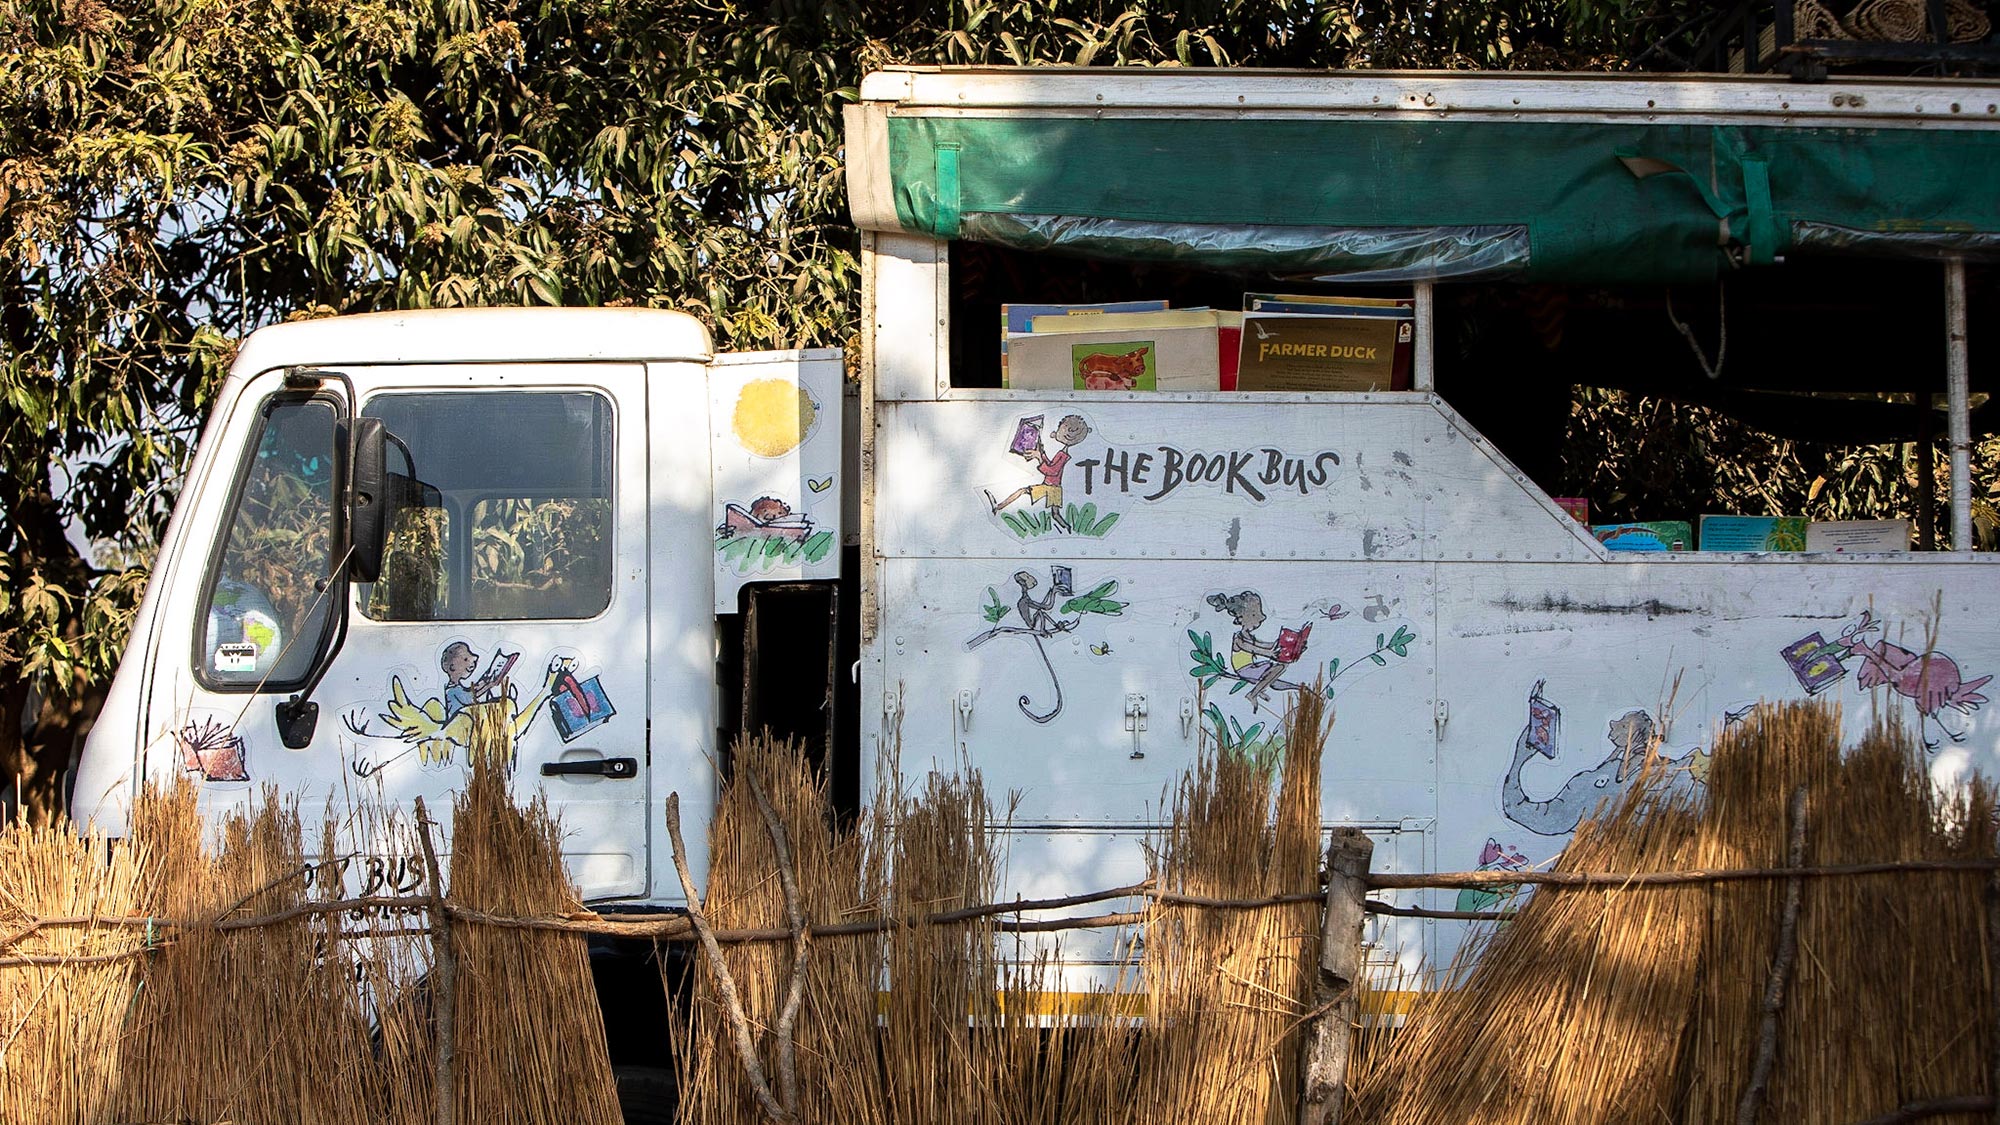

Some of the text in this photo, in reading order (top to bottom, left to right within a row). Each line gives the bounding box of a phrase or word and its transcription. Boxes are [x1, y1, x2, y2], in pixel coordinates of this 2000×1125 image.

[1259, 343, 1377, 362] FARMER DUCK
[1075, 446, 1340, 502] THE BOOK BUS
[359, 855, 425, 898] BUS
